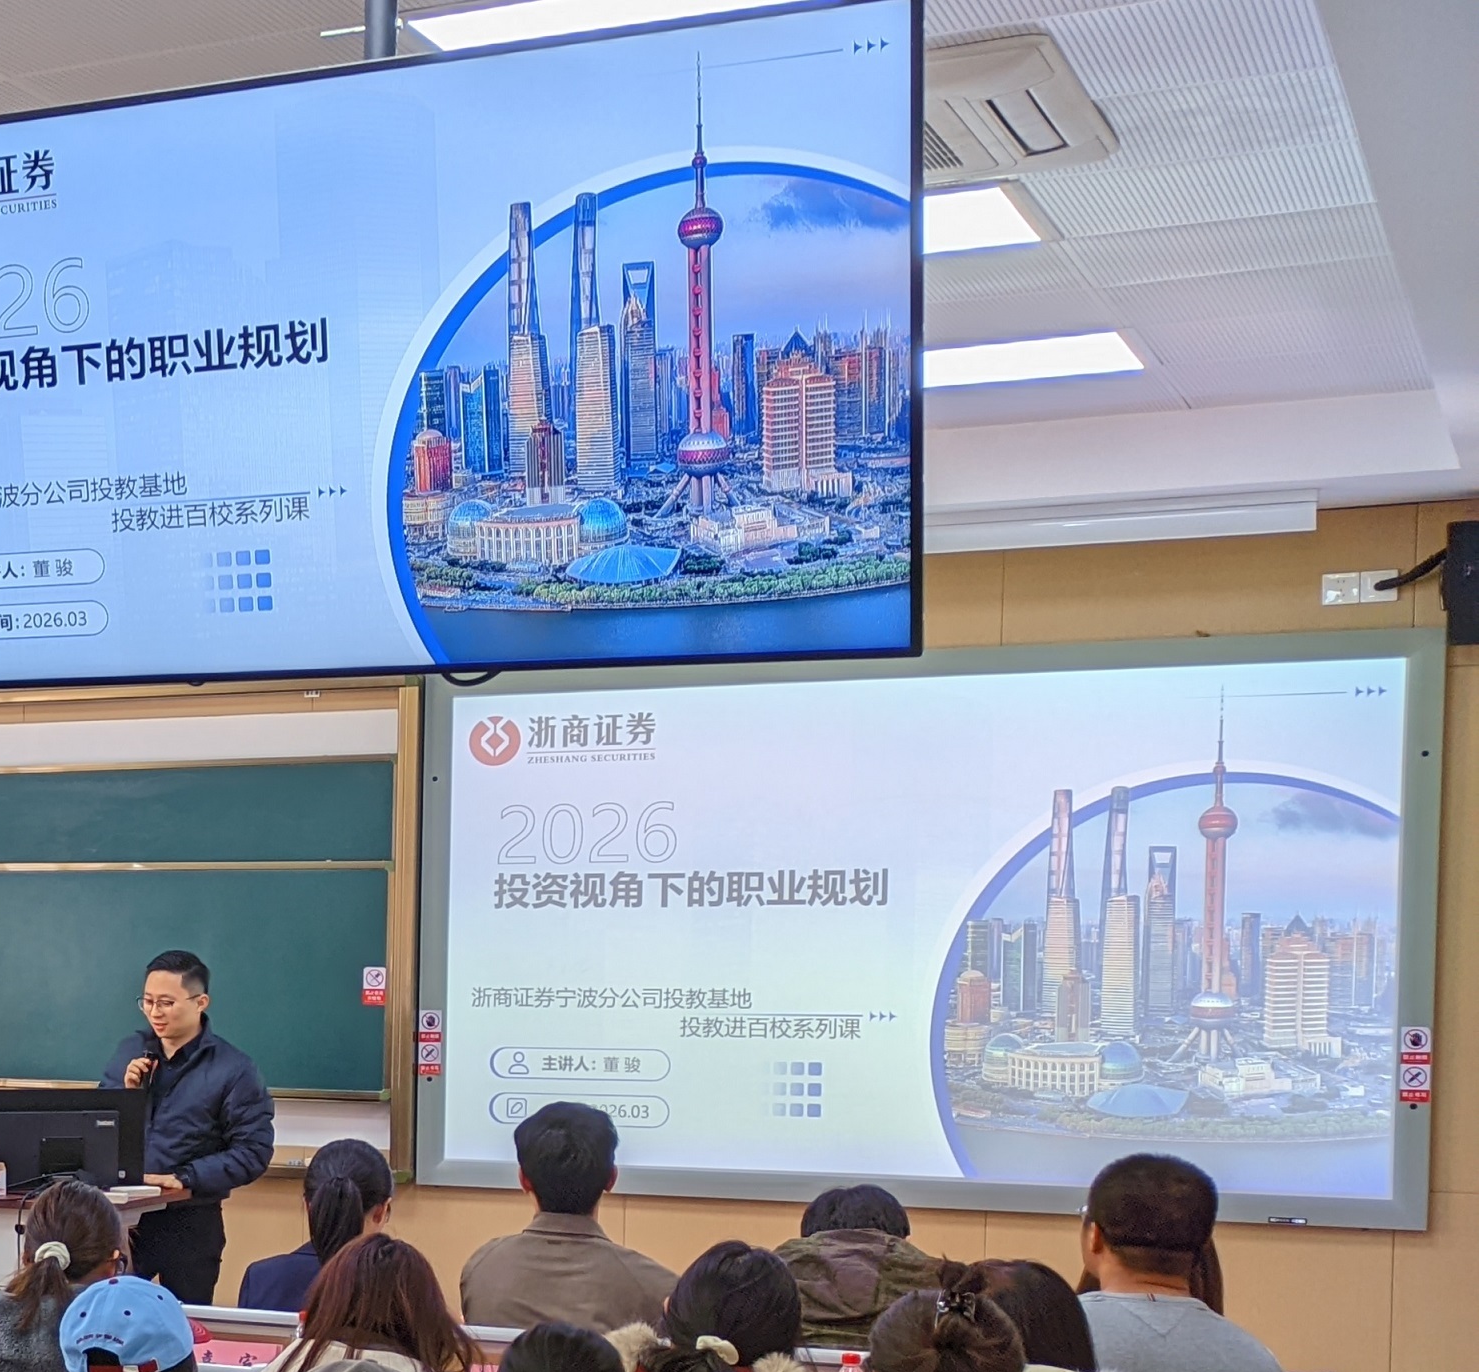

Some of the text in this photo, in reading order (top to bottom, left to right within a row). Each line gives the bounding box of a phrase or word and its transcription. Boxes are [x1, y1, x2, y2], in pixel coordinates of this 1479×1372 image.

[111, 497, 310, 532] 投教进百校系列课
[527, 712, 656, 749] 浙商证券
[527, 752, 656, 764] ZHESHANG SECURITIES
[497, 801, 677, 865] 2026
[494, 868, 889, 909] 投资视角下的职业规划
[471, 987, 752, 1010] 浙商证券宁波分公司投教基地
[680, 1016, 861, 1040] 投教进百校系列课
